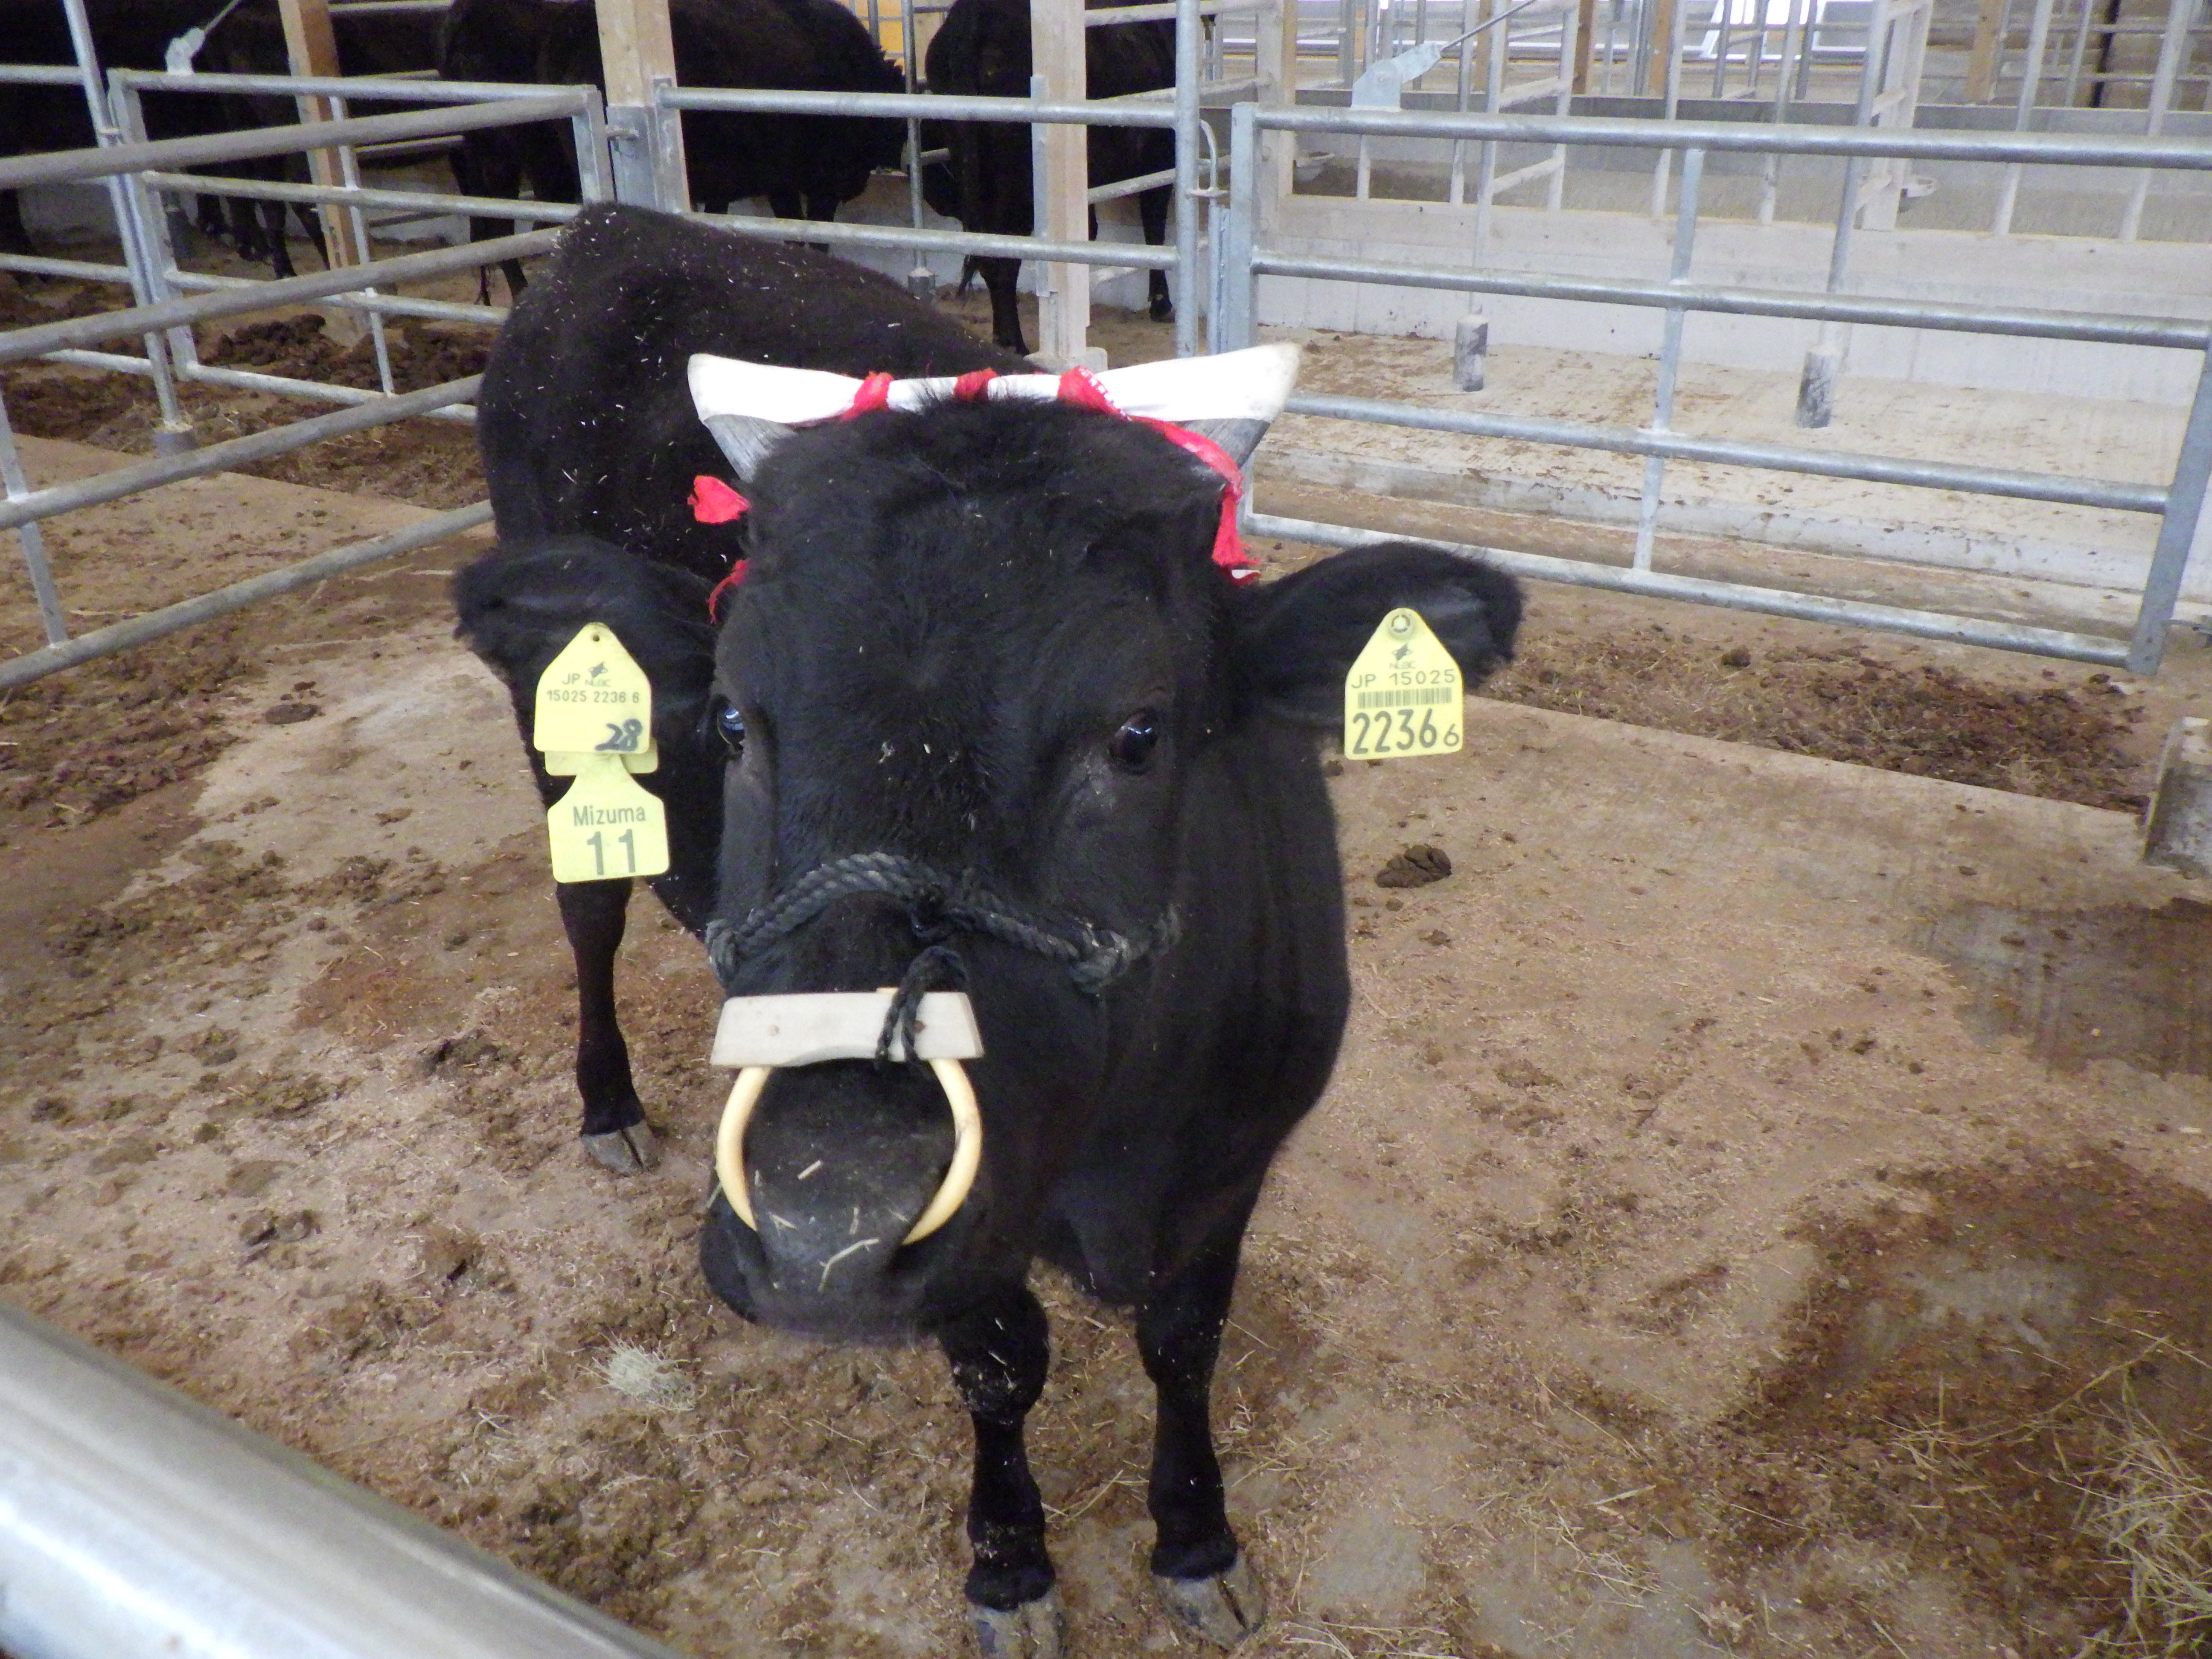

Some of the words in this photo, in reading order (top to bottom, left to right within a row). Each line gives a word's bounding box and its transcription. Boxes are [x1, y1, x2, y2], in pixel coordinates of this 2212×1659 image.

[562, 673, 580, 685] JP
[1351, 674, 1377, 688] JP
[1389, 669, 1455, 686] 15025
[546, 690, 587, 702] 15025
[594, 718, 643, 751] 28
[573, 805, 646, 827] Mizuma
[587, 829, 636, 875] 11
